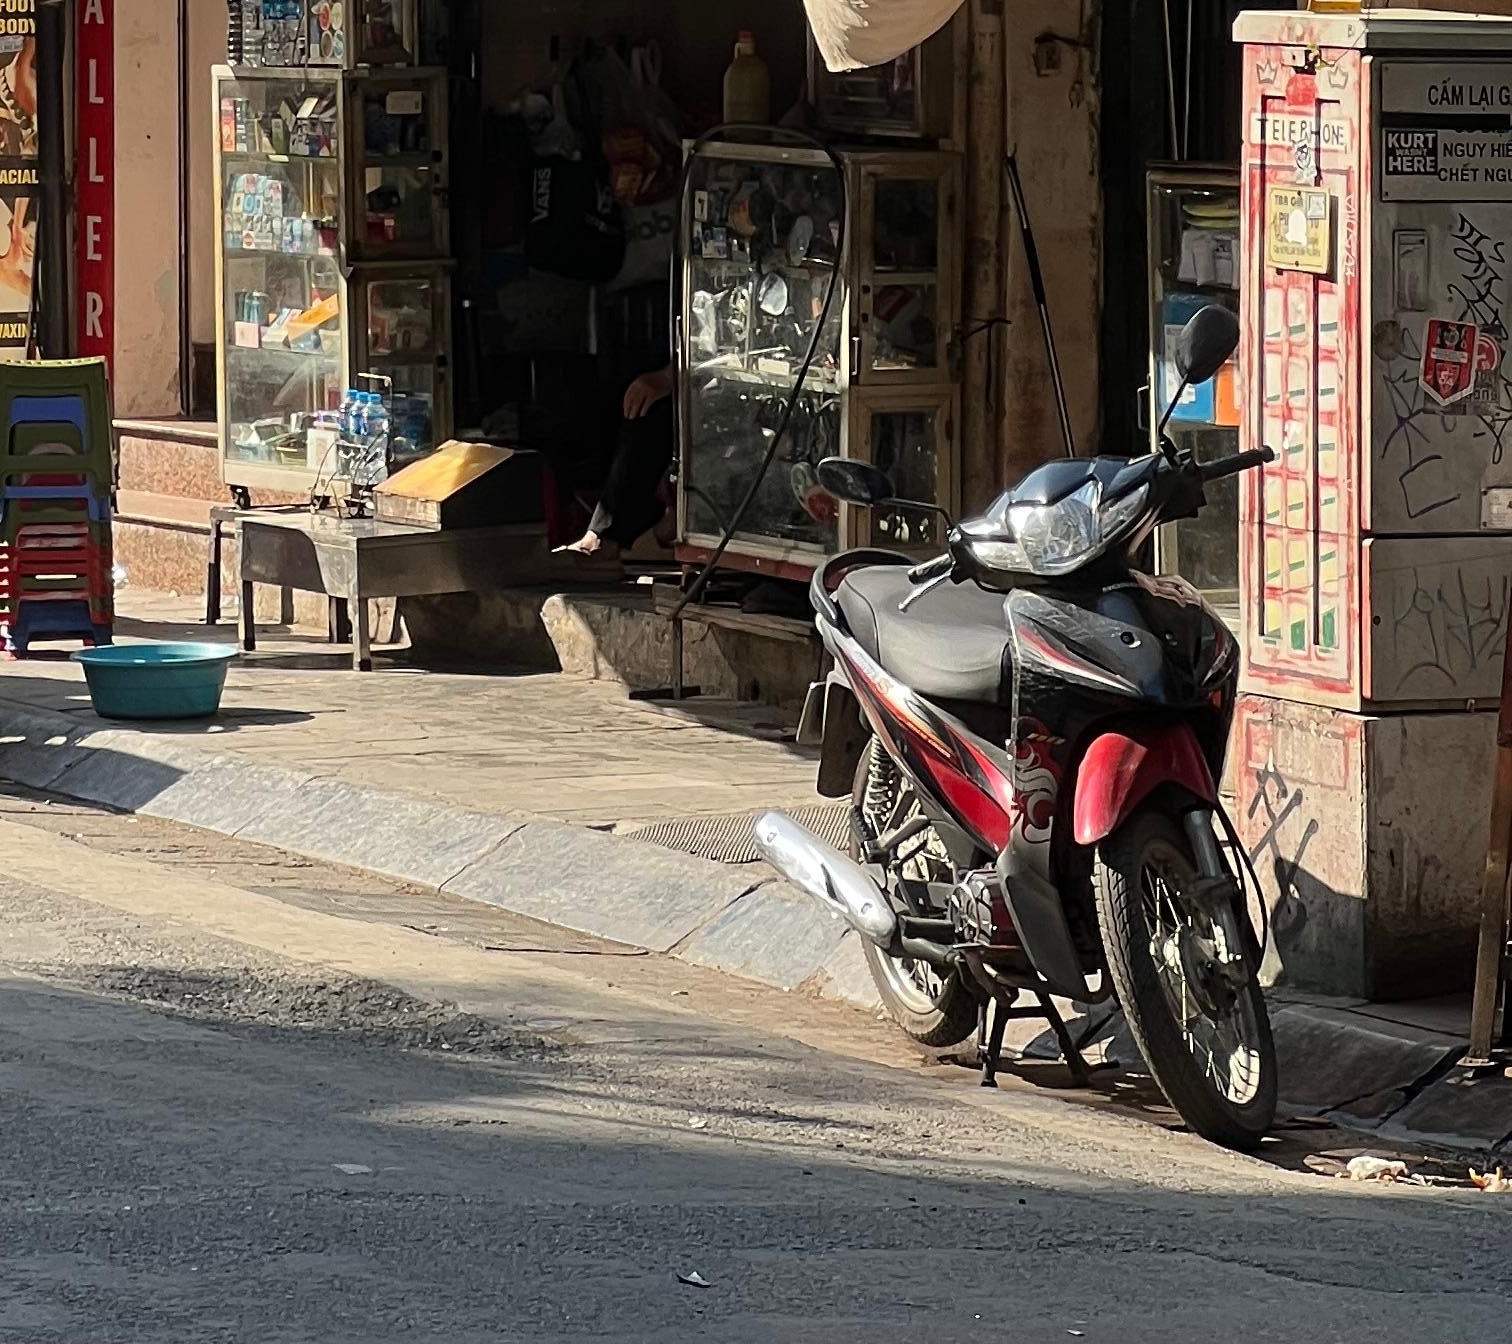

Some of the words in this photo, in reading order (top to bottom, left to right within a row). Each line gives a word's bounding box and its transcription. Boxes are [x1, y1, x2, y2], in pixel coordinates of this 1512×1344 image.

[1428, 77, 1464, 105] CẤM
[1469, 85, 1494, 111] LẠI
[1387, 133, 1436, 148] KURT
[1443, 143, 1486, 157] NGUY
[1388, 156, 1436, 172] HERE
[1438, 163, 1479, 182] CHẾT
[529, 167, 552, 224] VANS
